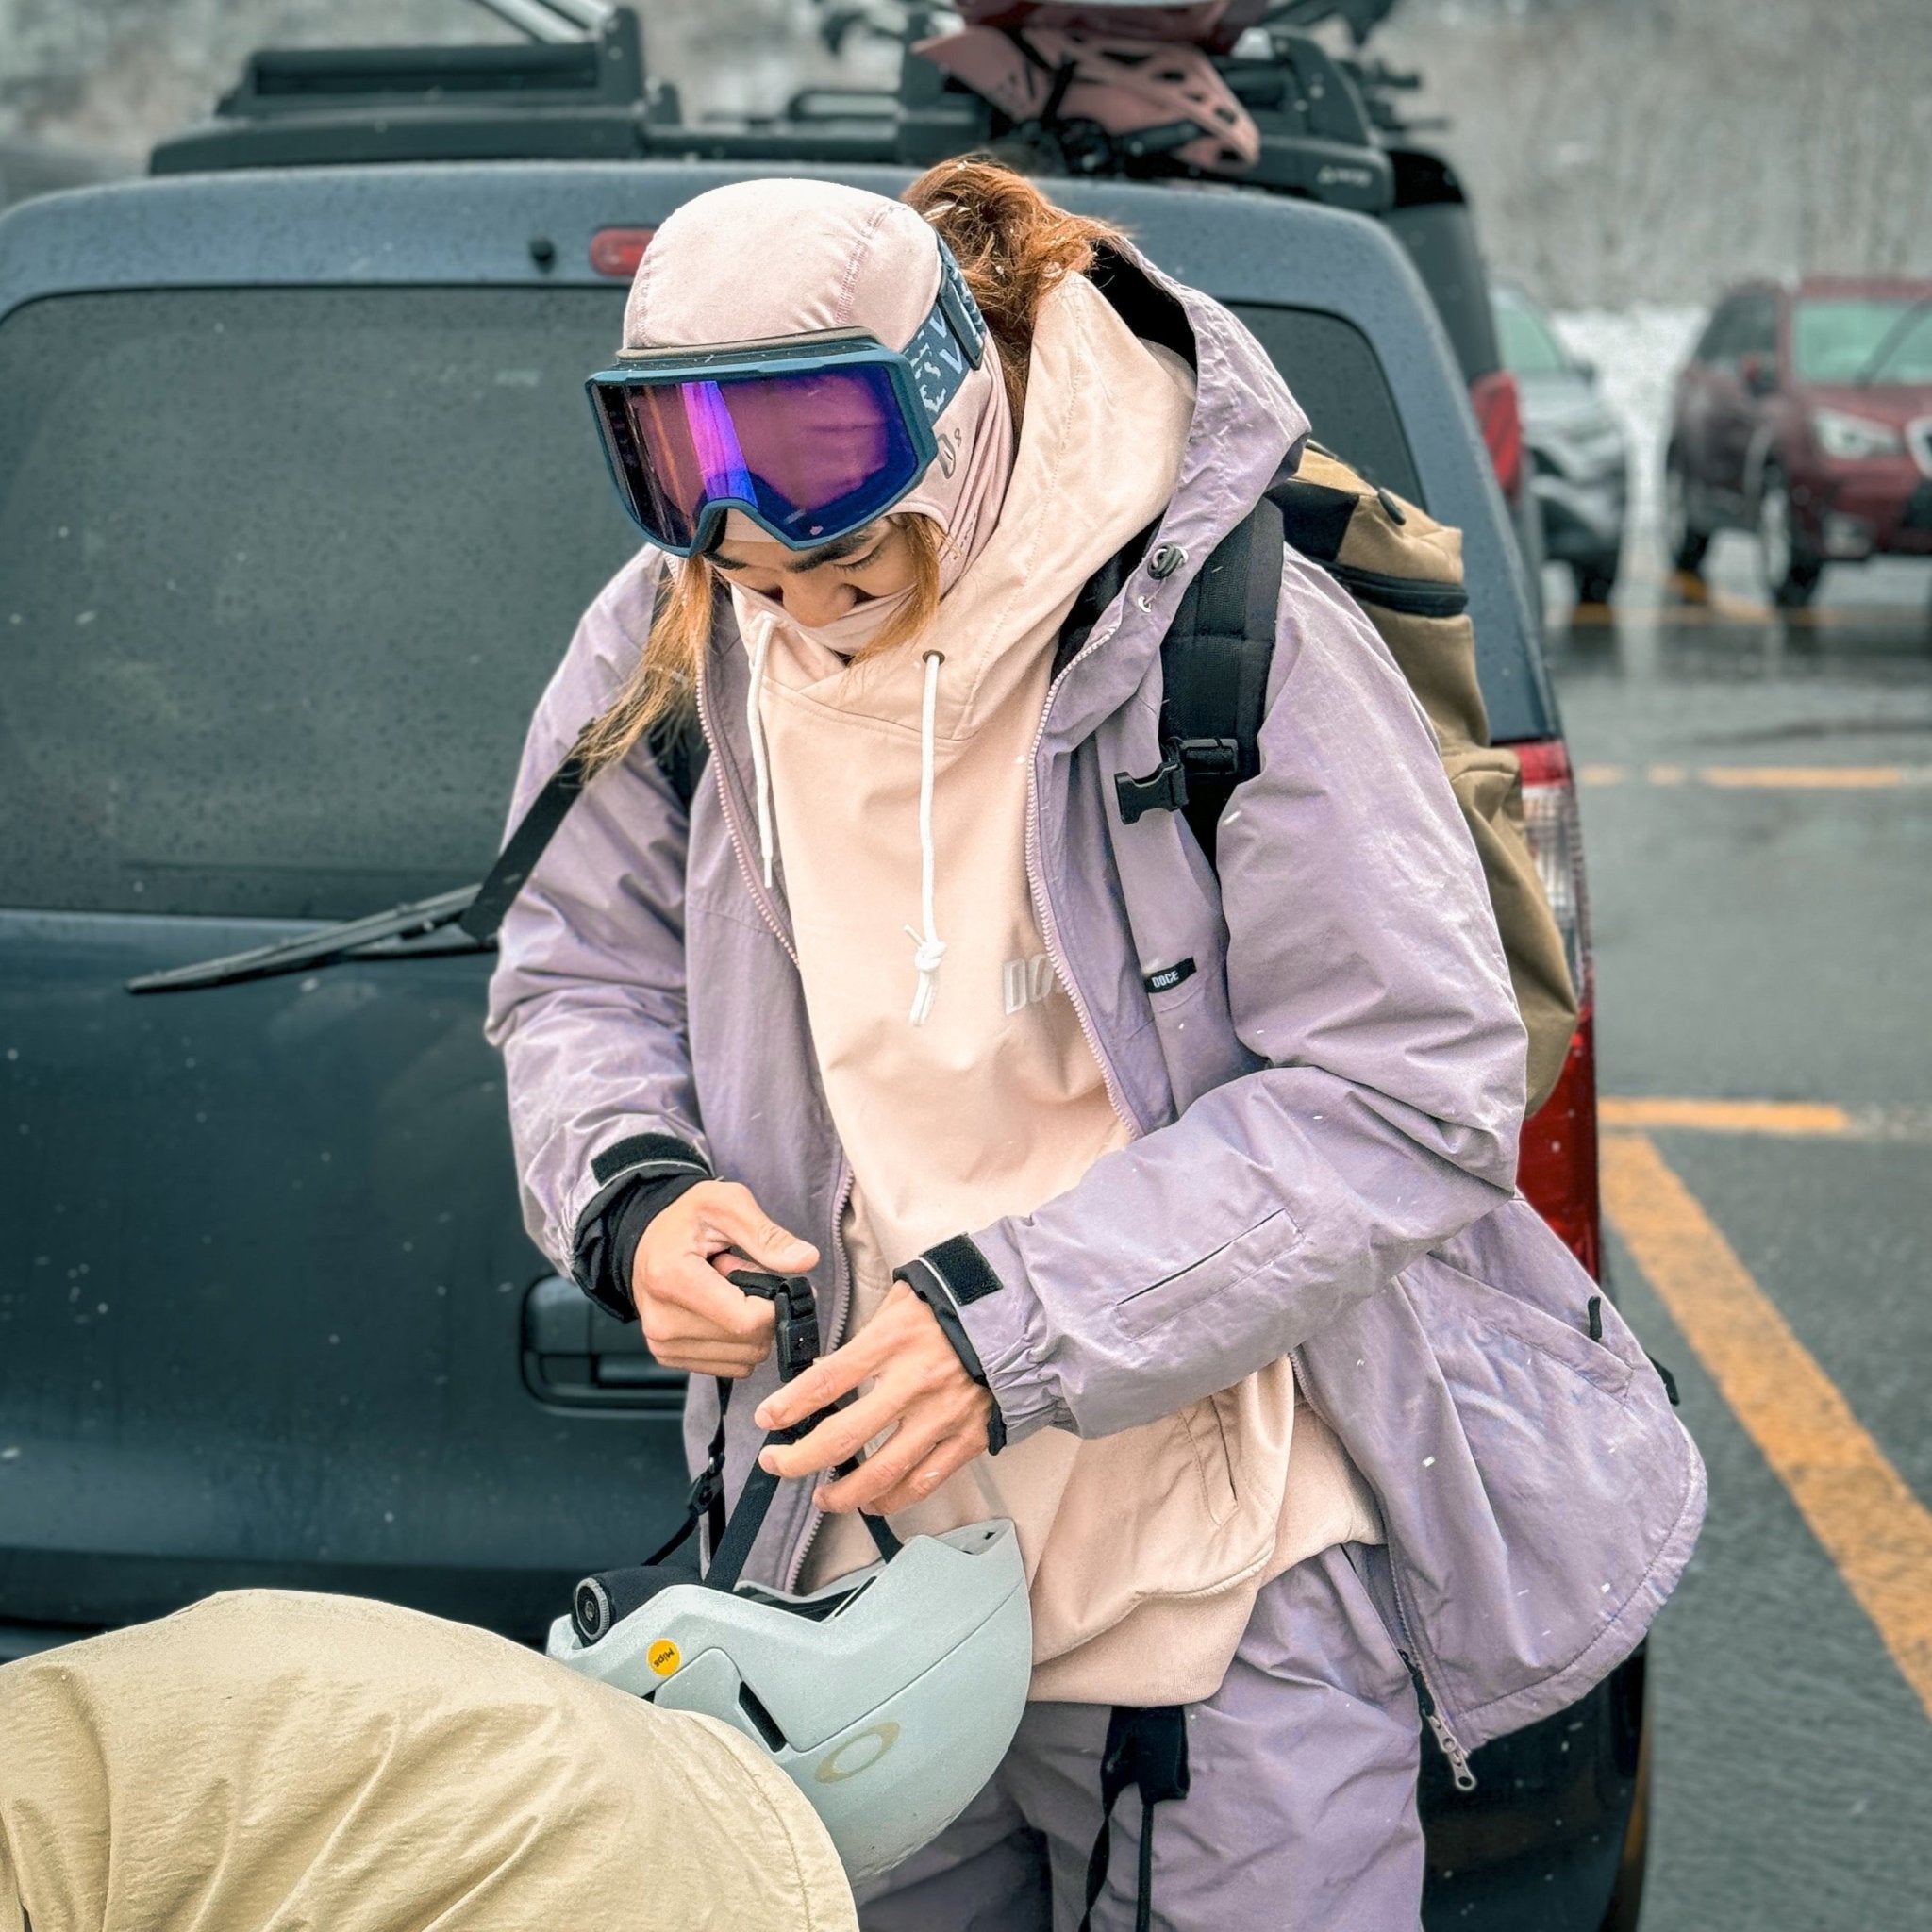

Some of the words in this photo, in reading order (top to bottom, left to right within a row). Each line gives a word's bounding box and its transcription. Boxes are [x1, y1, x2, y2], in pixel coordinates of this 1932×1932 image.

[1002, 952, 1065, 1016] DO
[1151, 970, 1179, 988] DOCE
[653, 1646, 675, 1668] Mips
